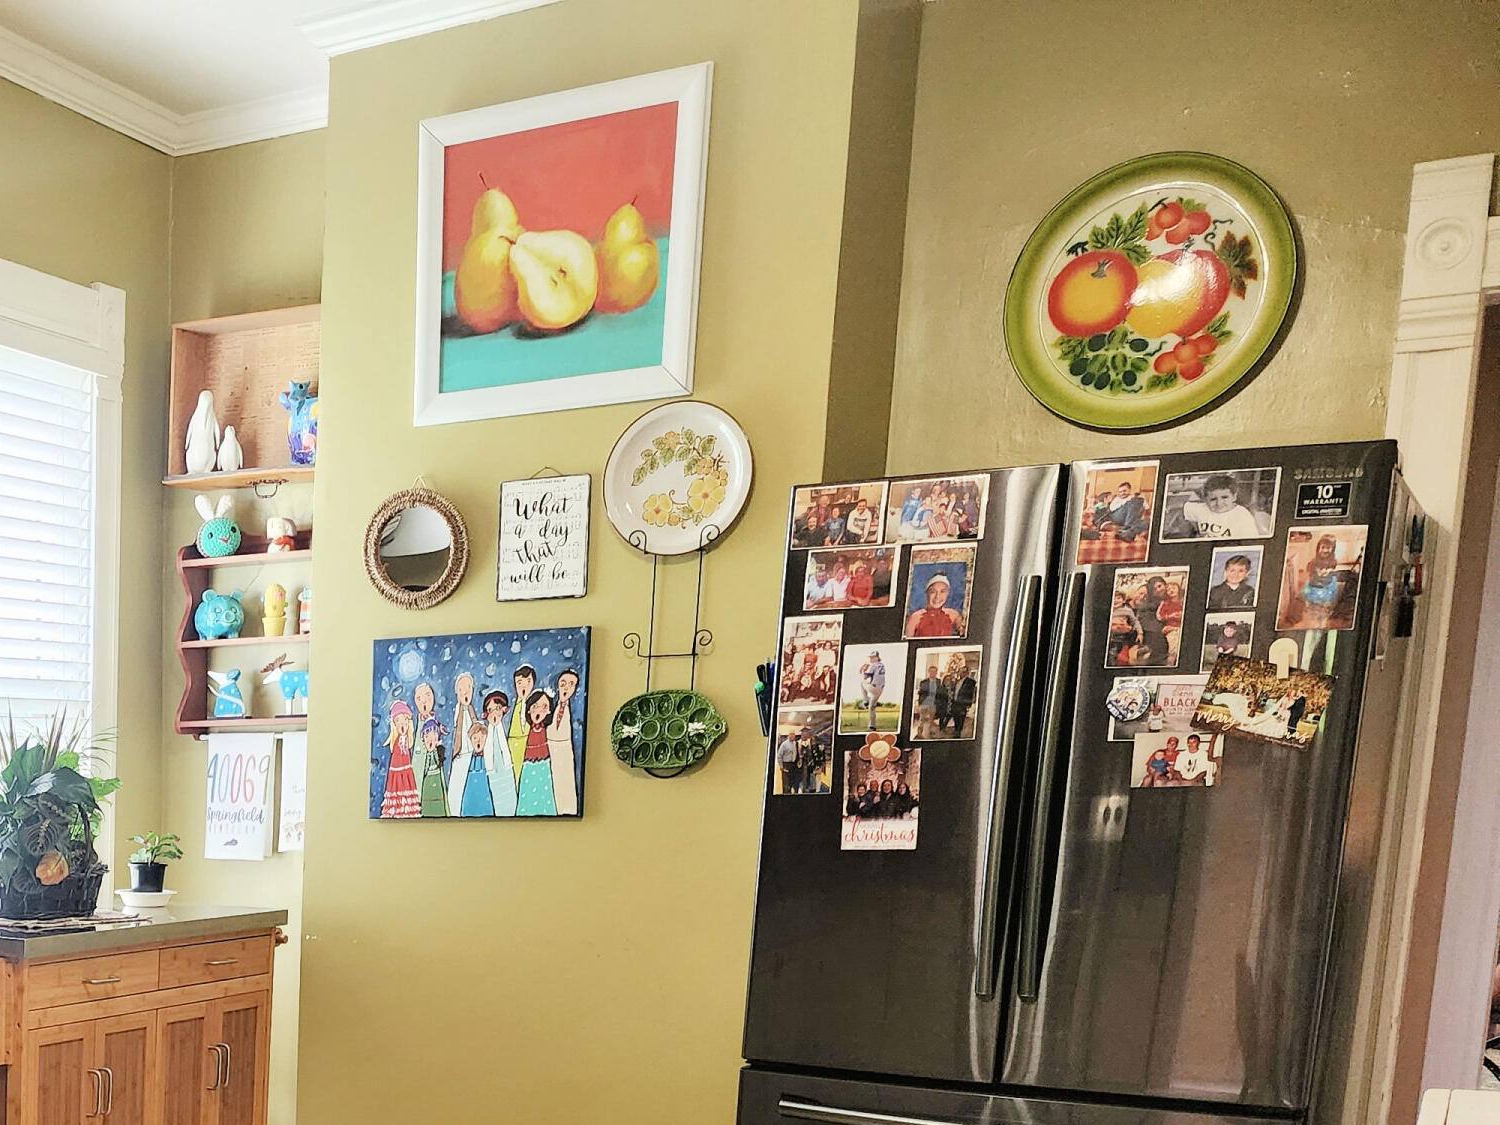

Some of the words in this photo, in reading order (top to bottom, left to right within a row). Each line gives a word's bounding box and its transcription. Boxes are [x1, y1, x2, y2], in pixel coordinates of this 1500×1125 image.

[1303, 498, 1344, 506] WARRANTY
[1316, 485, 1334, 499] 10
[513, 492, 573, 520] What
[514, 524, 525, 539] a
[539, 519, 568, 547] day
[513, 540, 555, 564] that
[510, 564, 546, 584] will
[552, 561, 567, 580] be
[1164, 697, 1196, 707] BLACK
[1196, 710, 1235, 731] Merry
[207, 753, 270, 806] 40069
